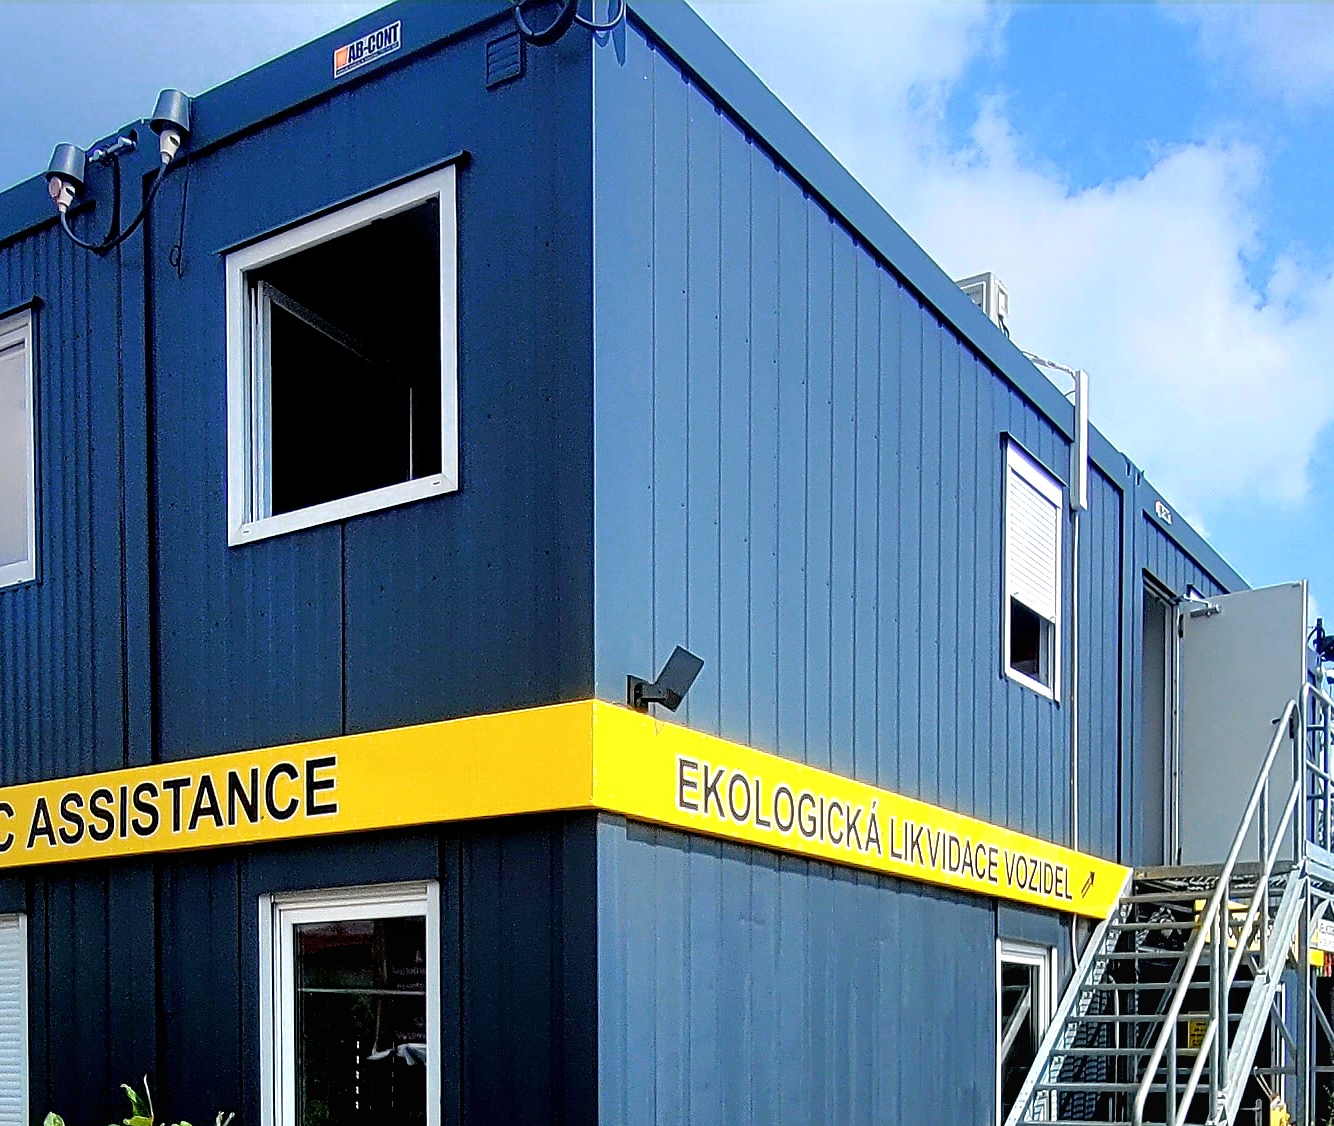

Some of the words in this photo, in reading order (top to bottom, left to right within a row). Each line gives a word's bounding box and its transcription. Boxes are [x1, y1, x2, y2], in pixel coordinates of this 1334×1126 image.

[348, 23, 399, 62] AB-CONT
[26, 756, 338, 849] ASSISTANCE
[679, 757, 882, 855] EKOLOGICKÁ
[890, 818, 999, 883] LIKVIDACE
[1005, 850, 1073, 901] VOZIDEL
